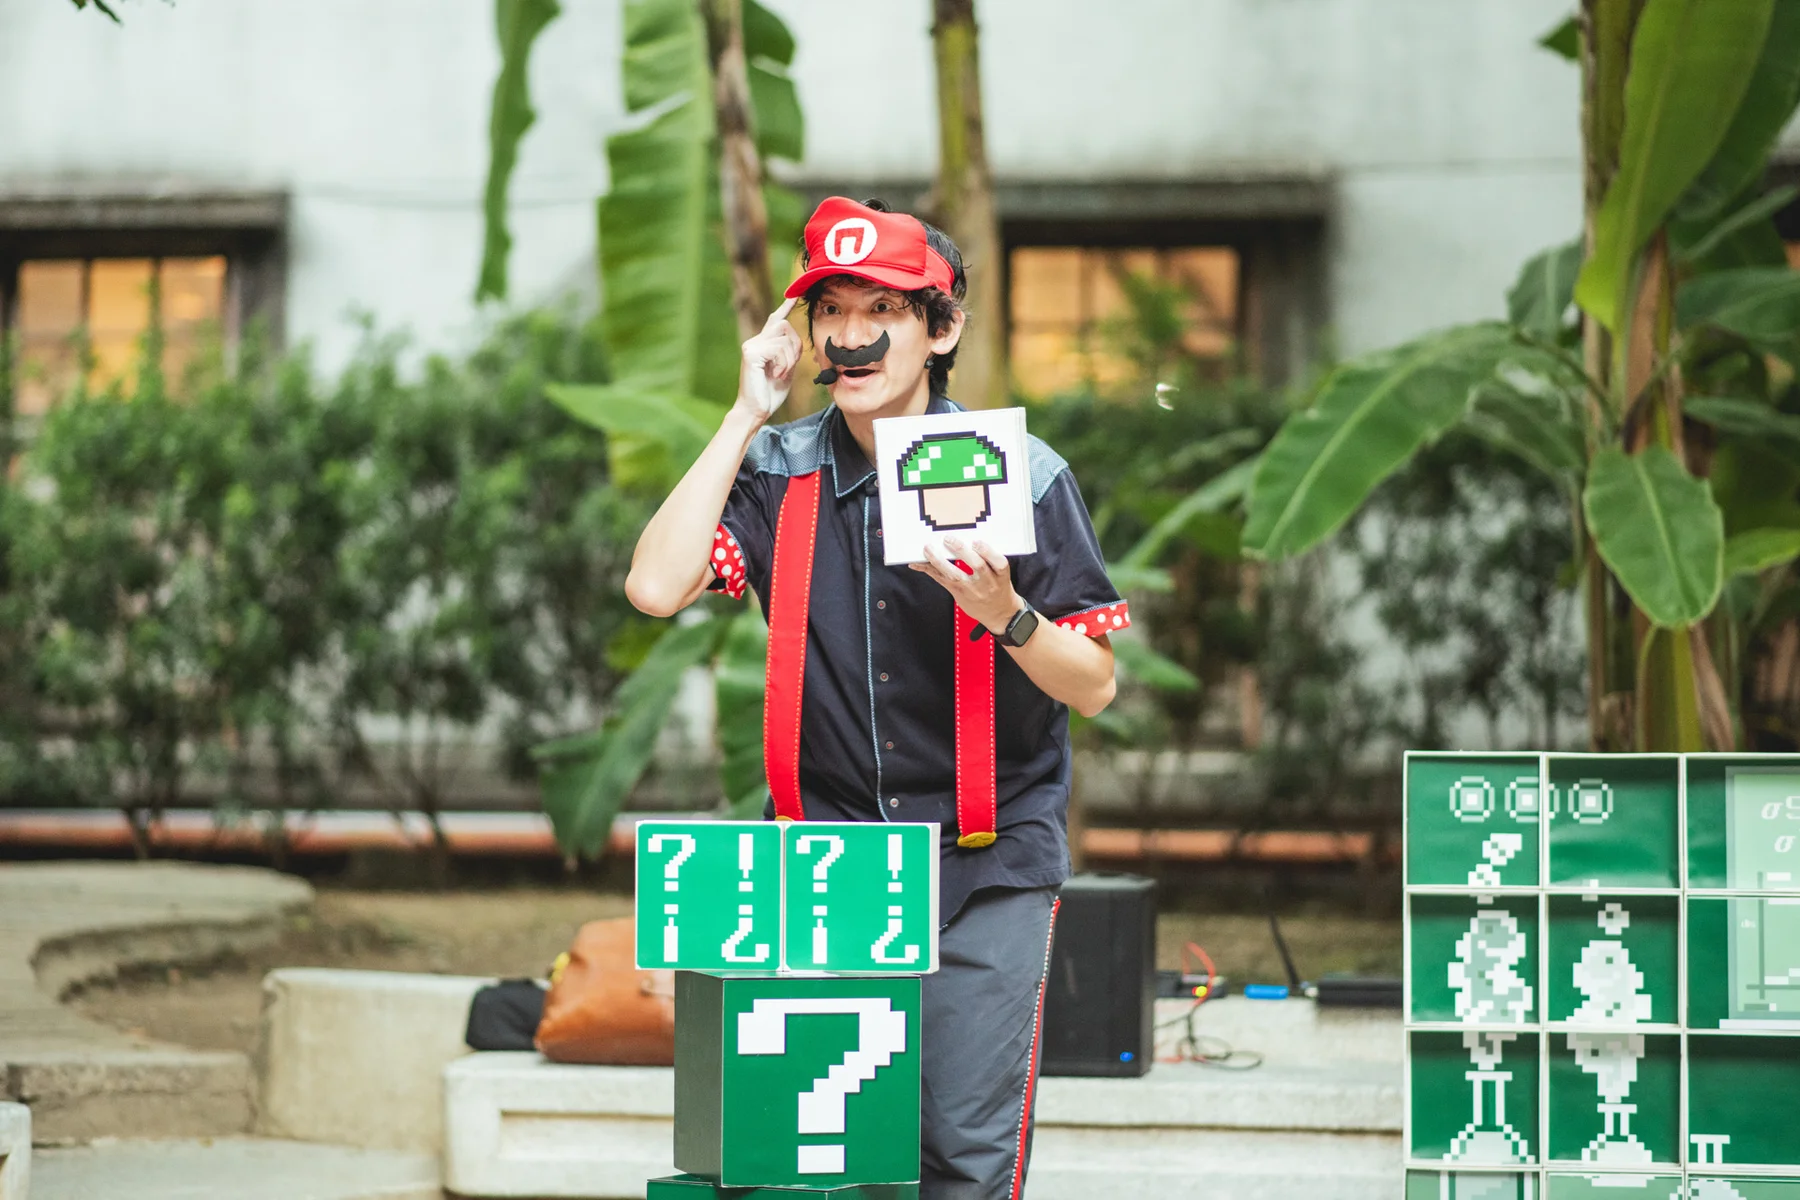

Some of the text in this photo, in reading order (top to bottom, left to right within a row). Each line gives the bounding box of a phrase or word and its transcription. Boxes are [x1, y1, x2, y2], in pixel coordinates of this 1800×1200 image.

[648, 833, 754, 892] ? !
[796, 834, 903, 893] ? !
[737, 998, 906, 1174] ?
